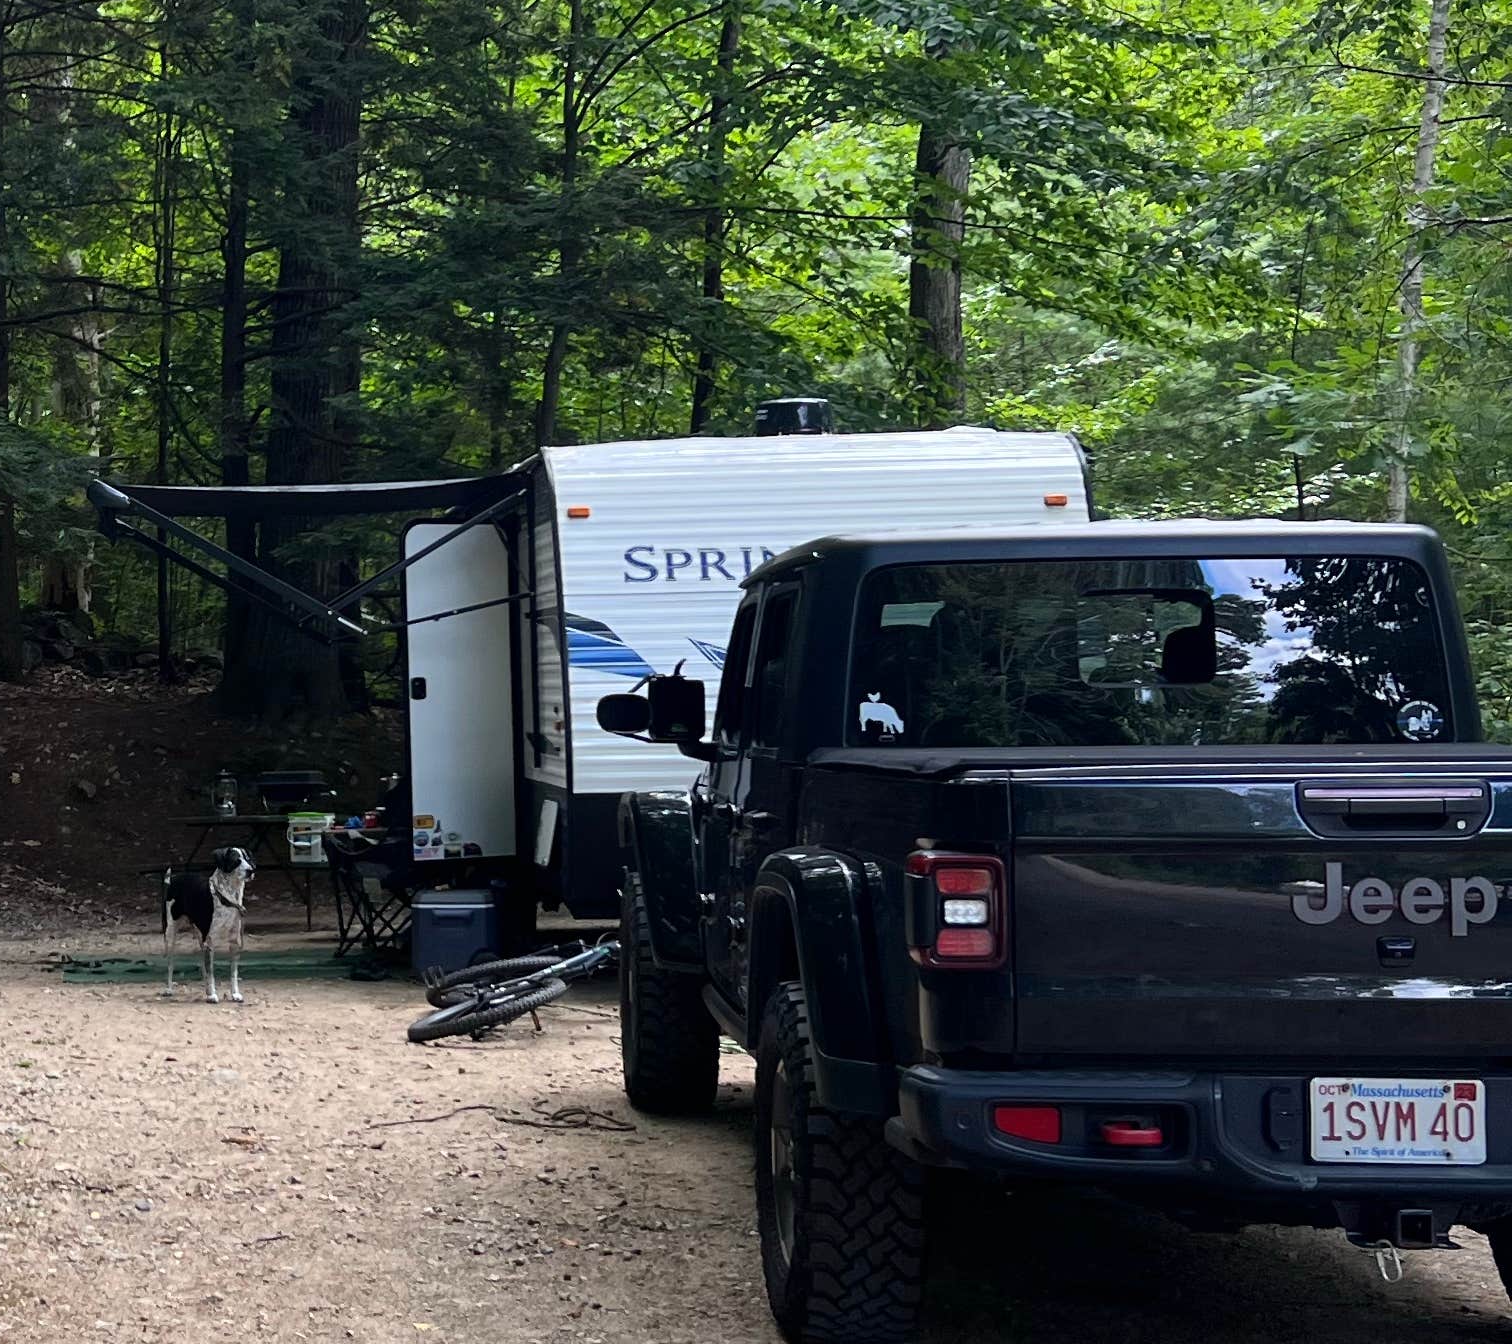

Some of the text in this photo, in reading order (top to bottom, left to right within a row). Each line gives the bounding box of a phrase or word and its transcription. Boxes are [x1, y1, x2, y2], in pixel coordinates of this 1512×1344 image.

[1292, 862, 1498, 936] Jeep
[1318, 1084, 1345, 1096] OCT
[1350, 1082, 1445, 1098] Massachusetts
[1322, 1101, 1475, 1143] 1SVM 40
